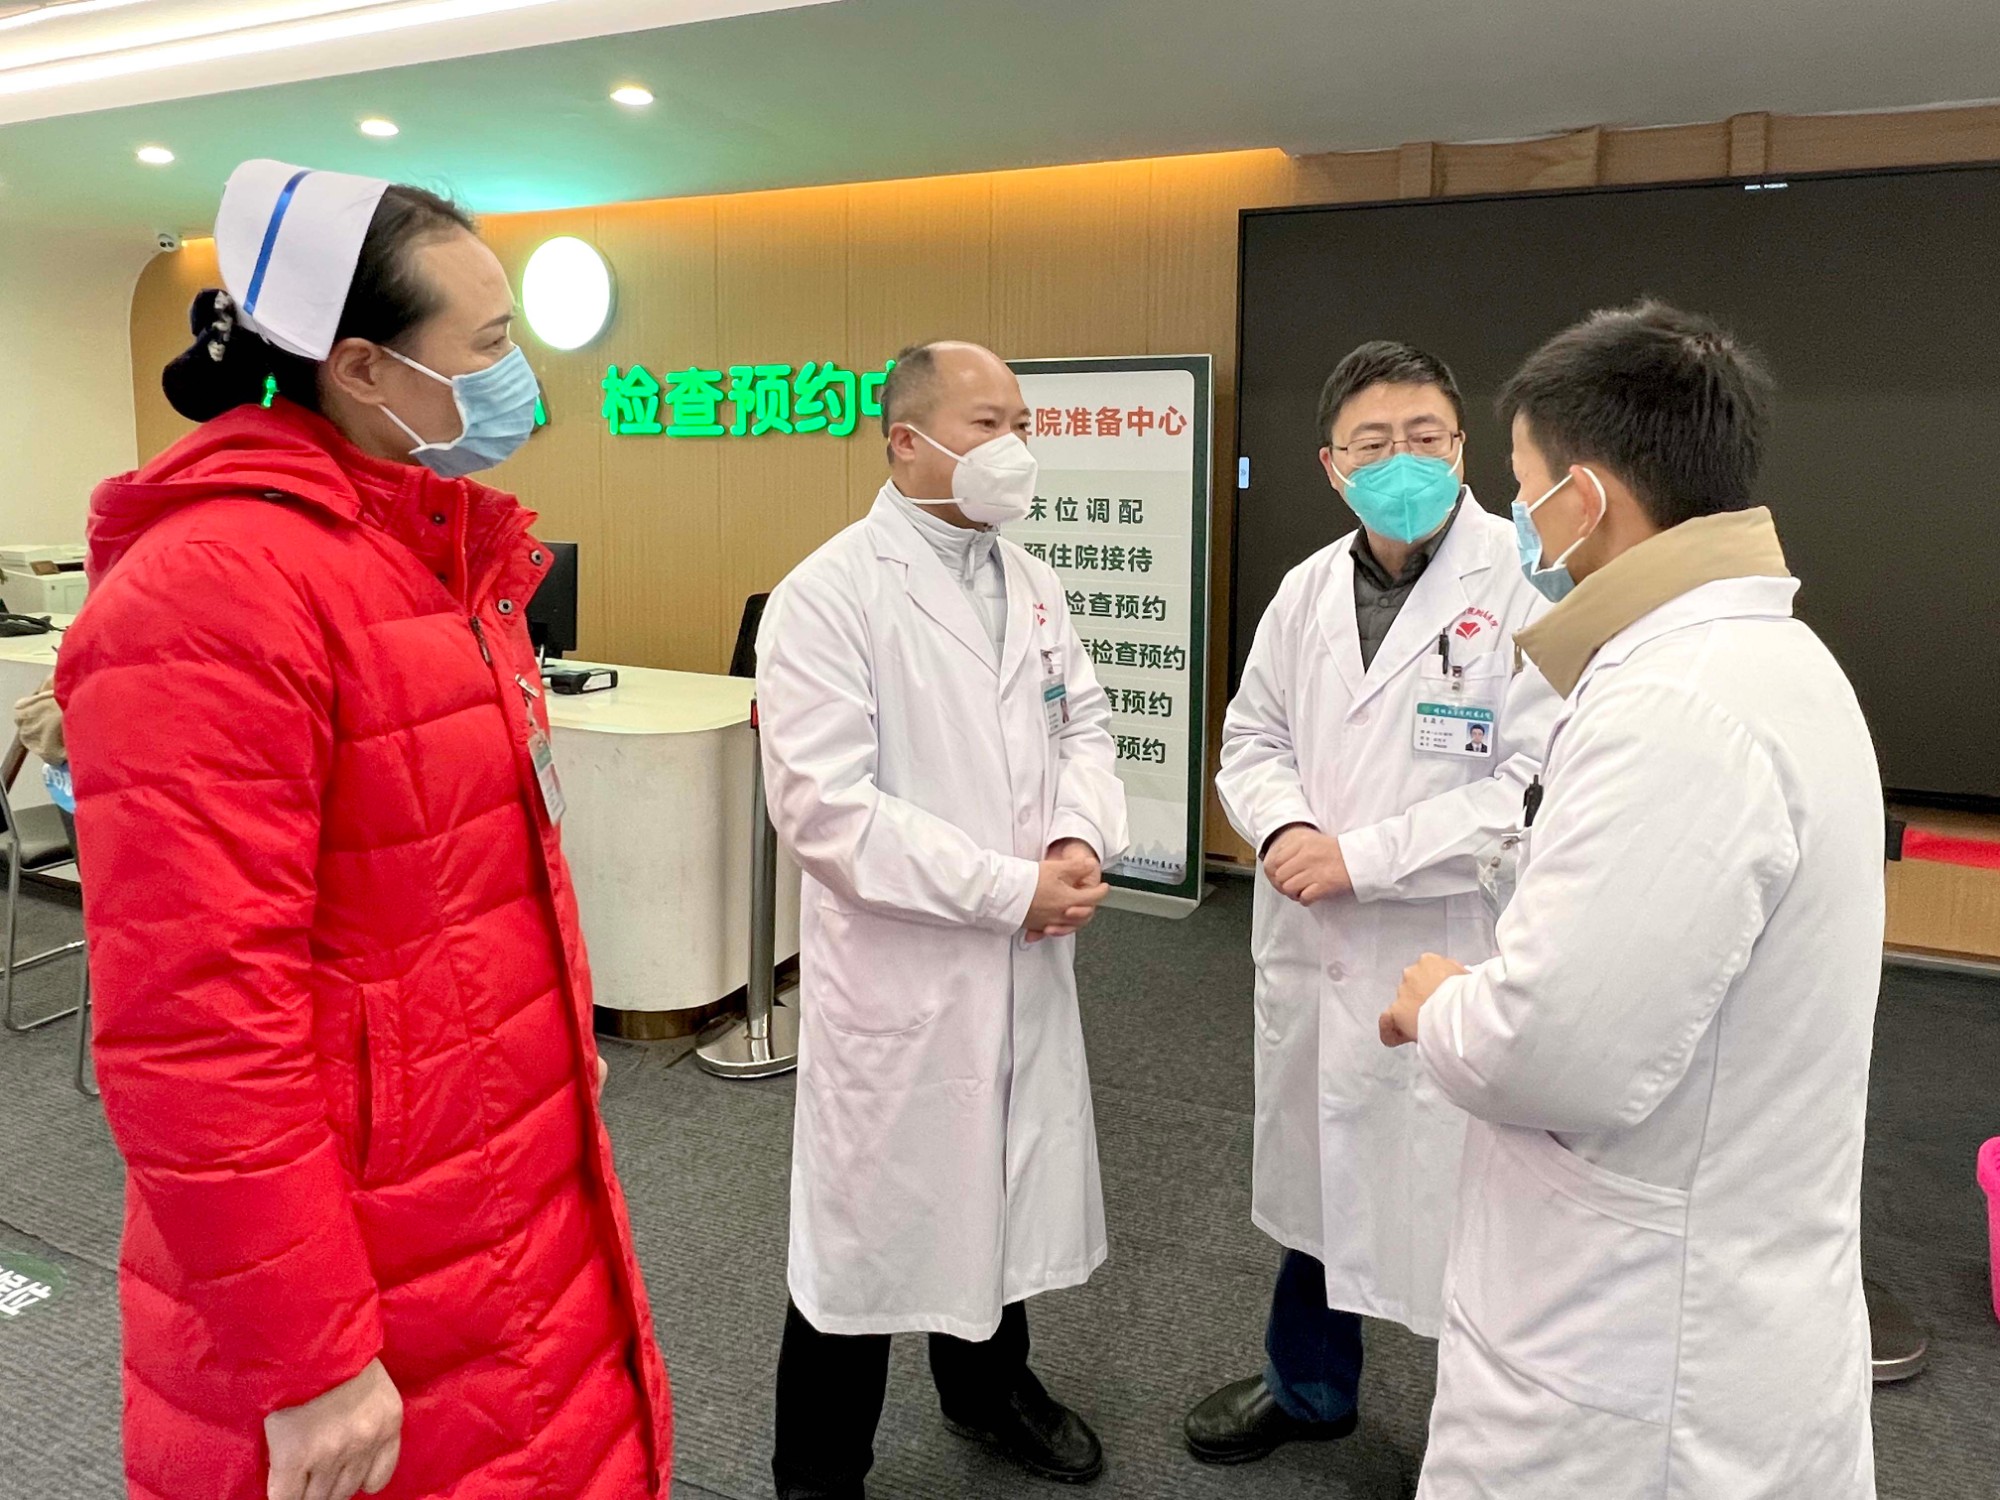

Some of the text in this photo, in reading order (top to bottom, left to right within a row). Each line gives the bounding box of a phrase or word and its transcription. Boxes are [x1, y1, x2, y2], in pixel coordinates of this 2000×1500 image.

[1027, 405, 1188, 438] 院准备中心
[1024, 495, 1144, 525] 床位调配
[1081, 637, 1186, 671] 检查预约
